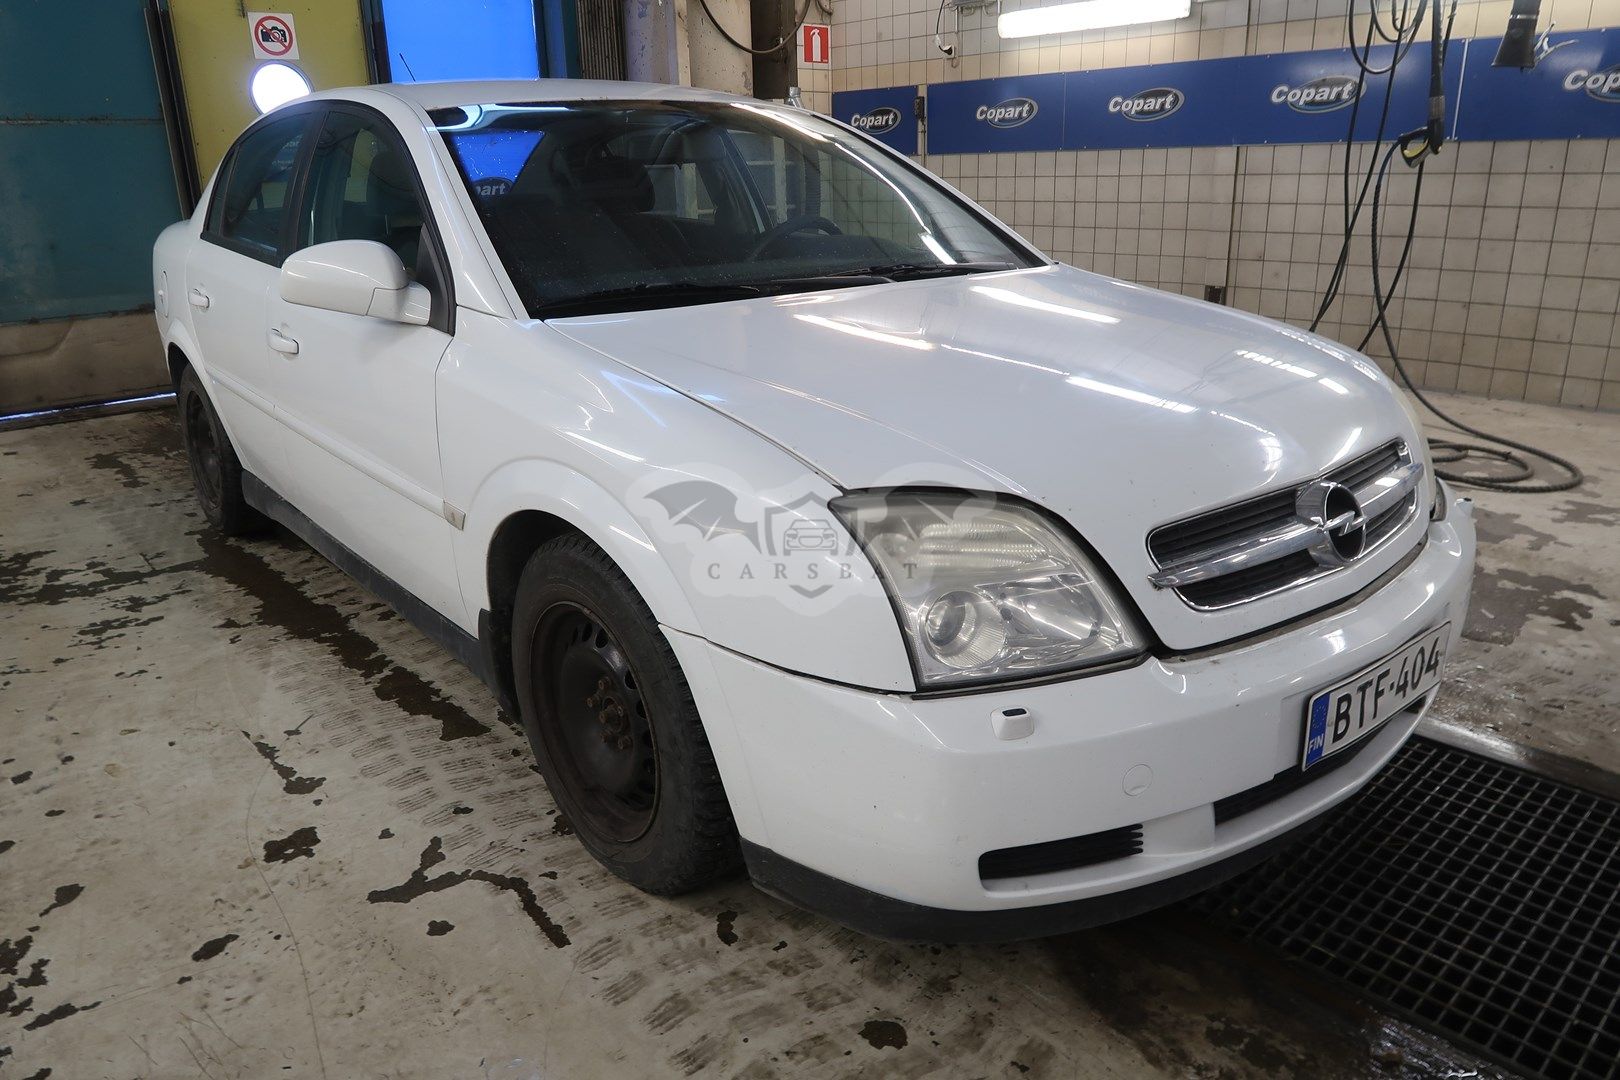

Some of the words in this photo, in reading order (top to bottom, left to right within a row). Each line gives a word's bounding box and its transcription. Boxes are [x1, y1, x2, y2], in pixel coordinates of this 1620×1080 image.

[1109, 93, 1174, 115] Copart
[1271, 82, 1353, 105] Copart
[851, 113, 895, 128] Copart
[977, 103, 1031, 121] Copart
[1333, 637, 1440, 744] BTF-404
[1308, 733, 1324, 754] FIN
